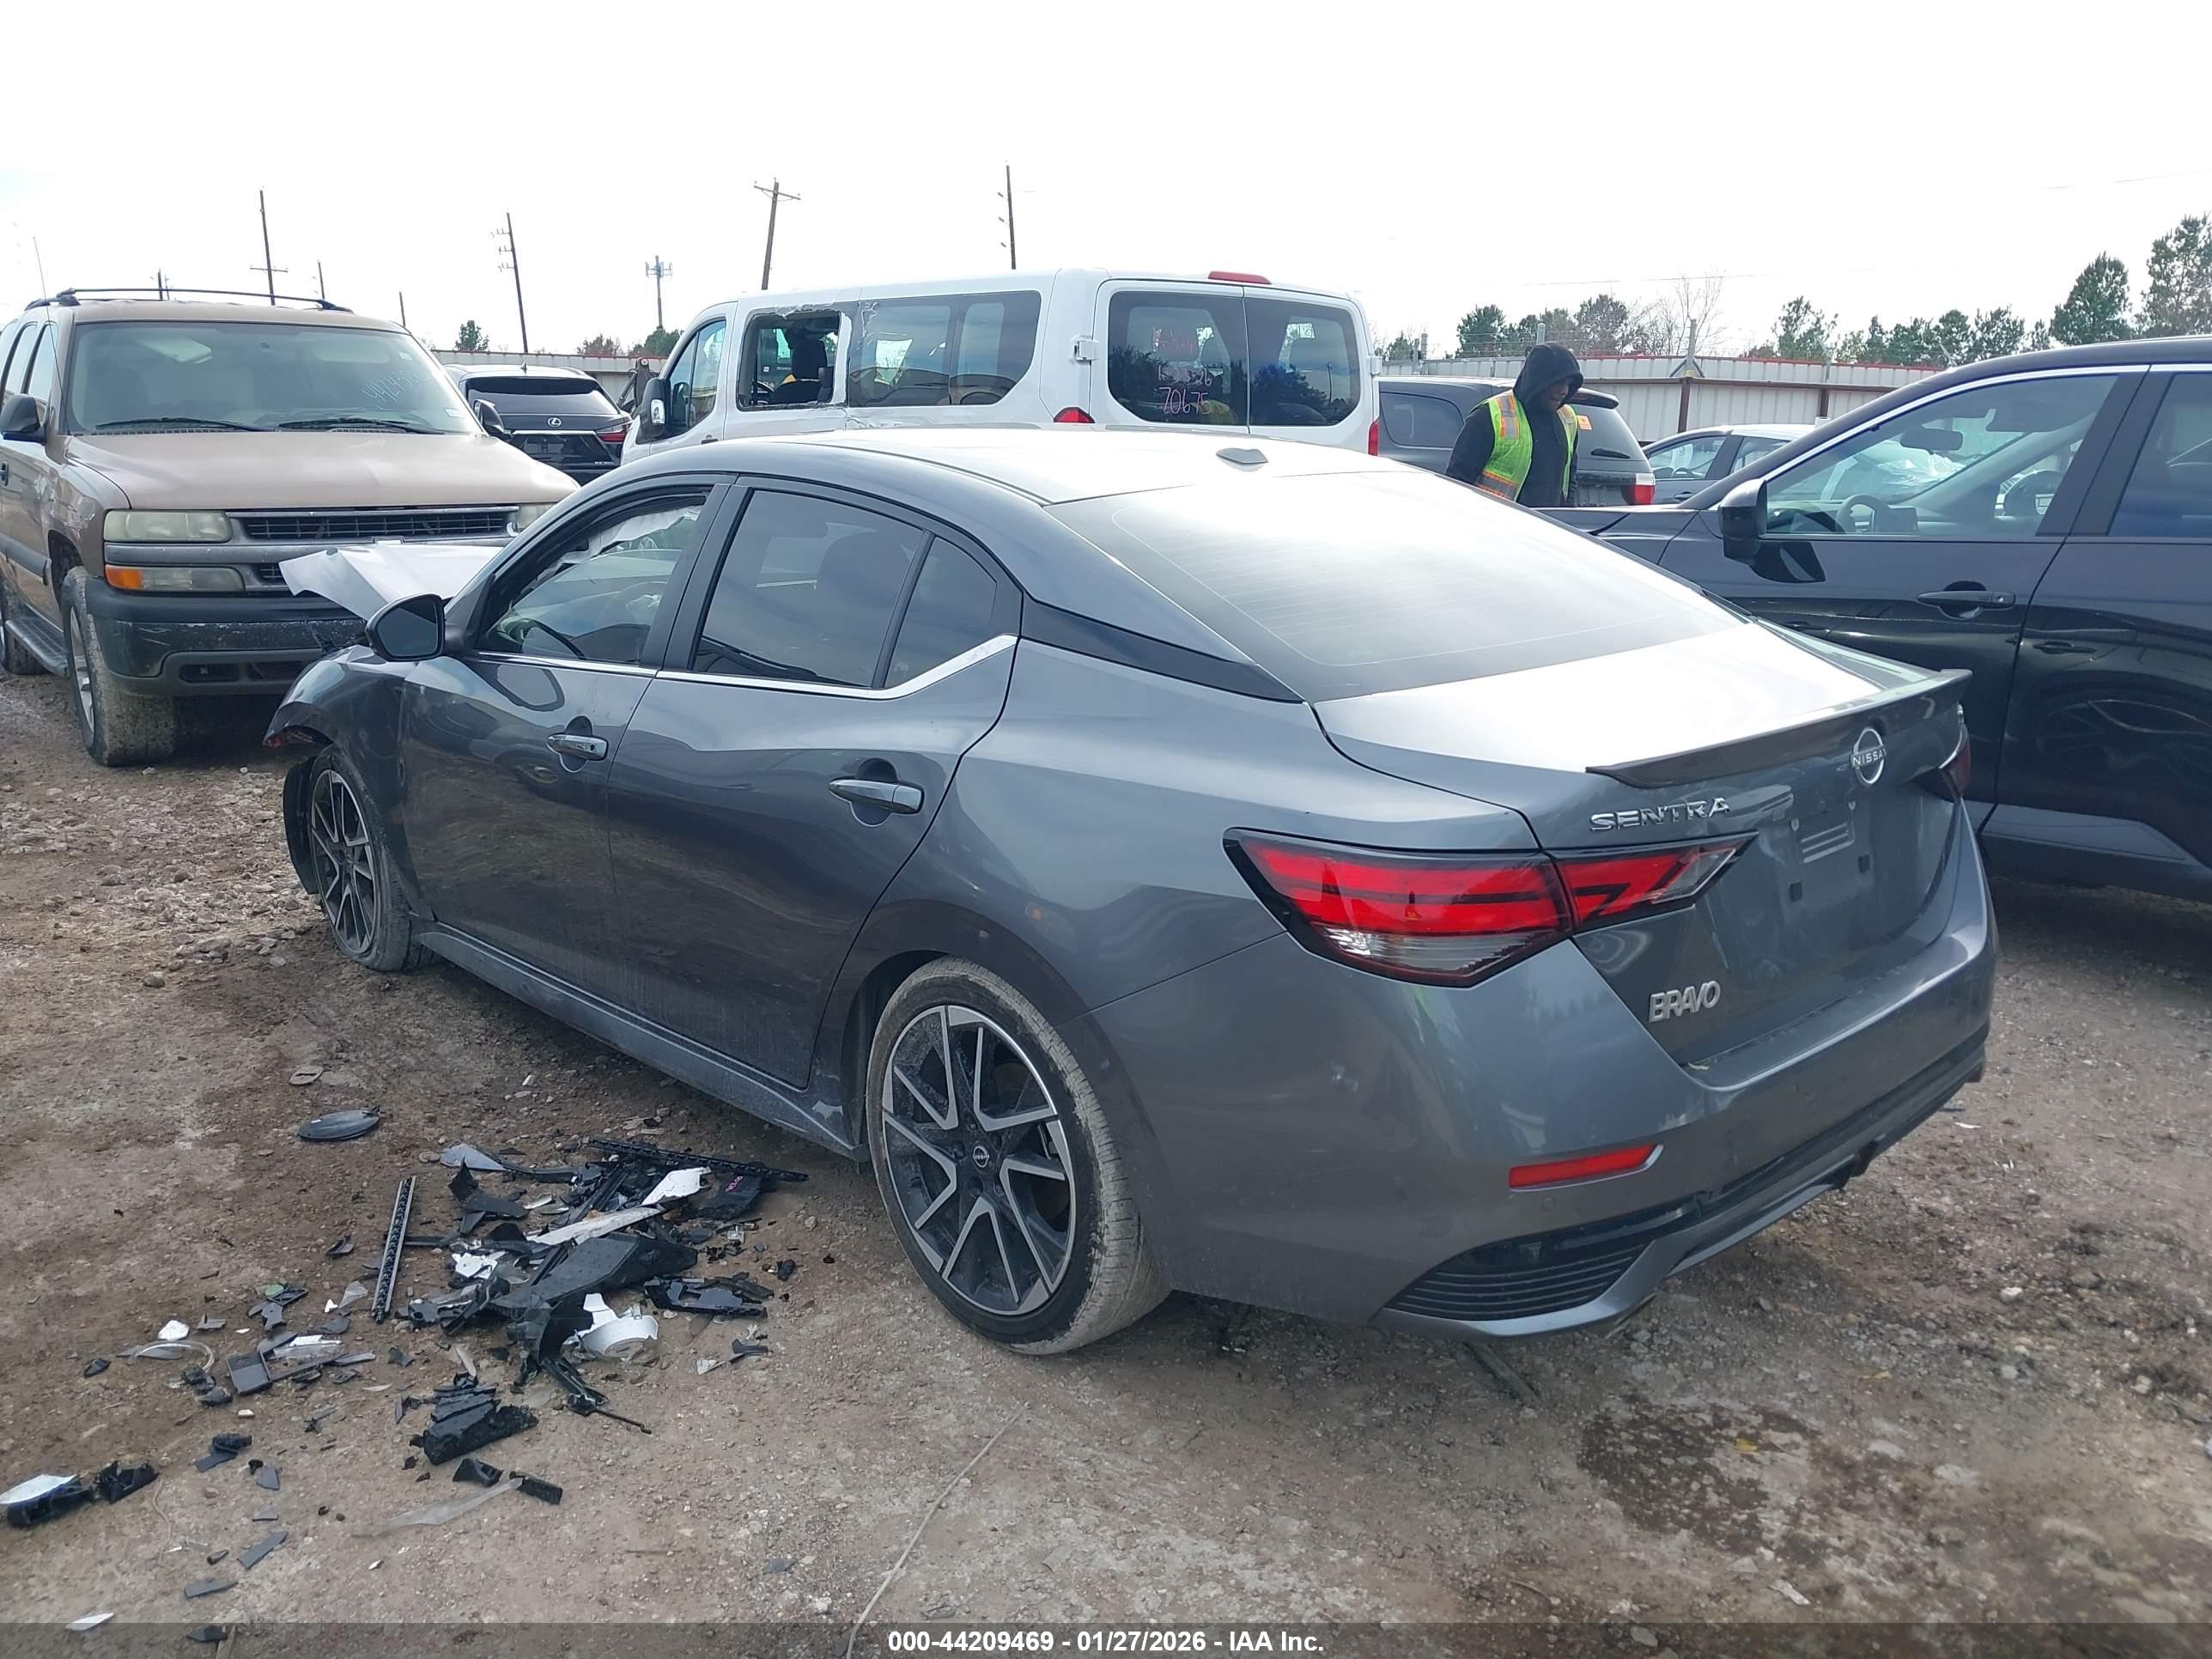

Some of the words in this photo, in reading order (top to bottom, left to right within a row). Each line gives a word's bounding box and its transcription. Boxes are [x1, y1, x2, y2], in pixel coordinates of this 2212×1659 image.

[1158, 386, 1212, 414] 70675
[1590, 797, 1730, 832] SENTRA
[1649, 980, 1722, 1024] BRAVO
